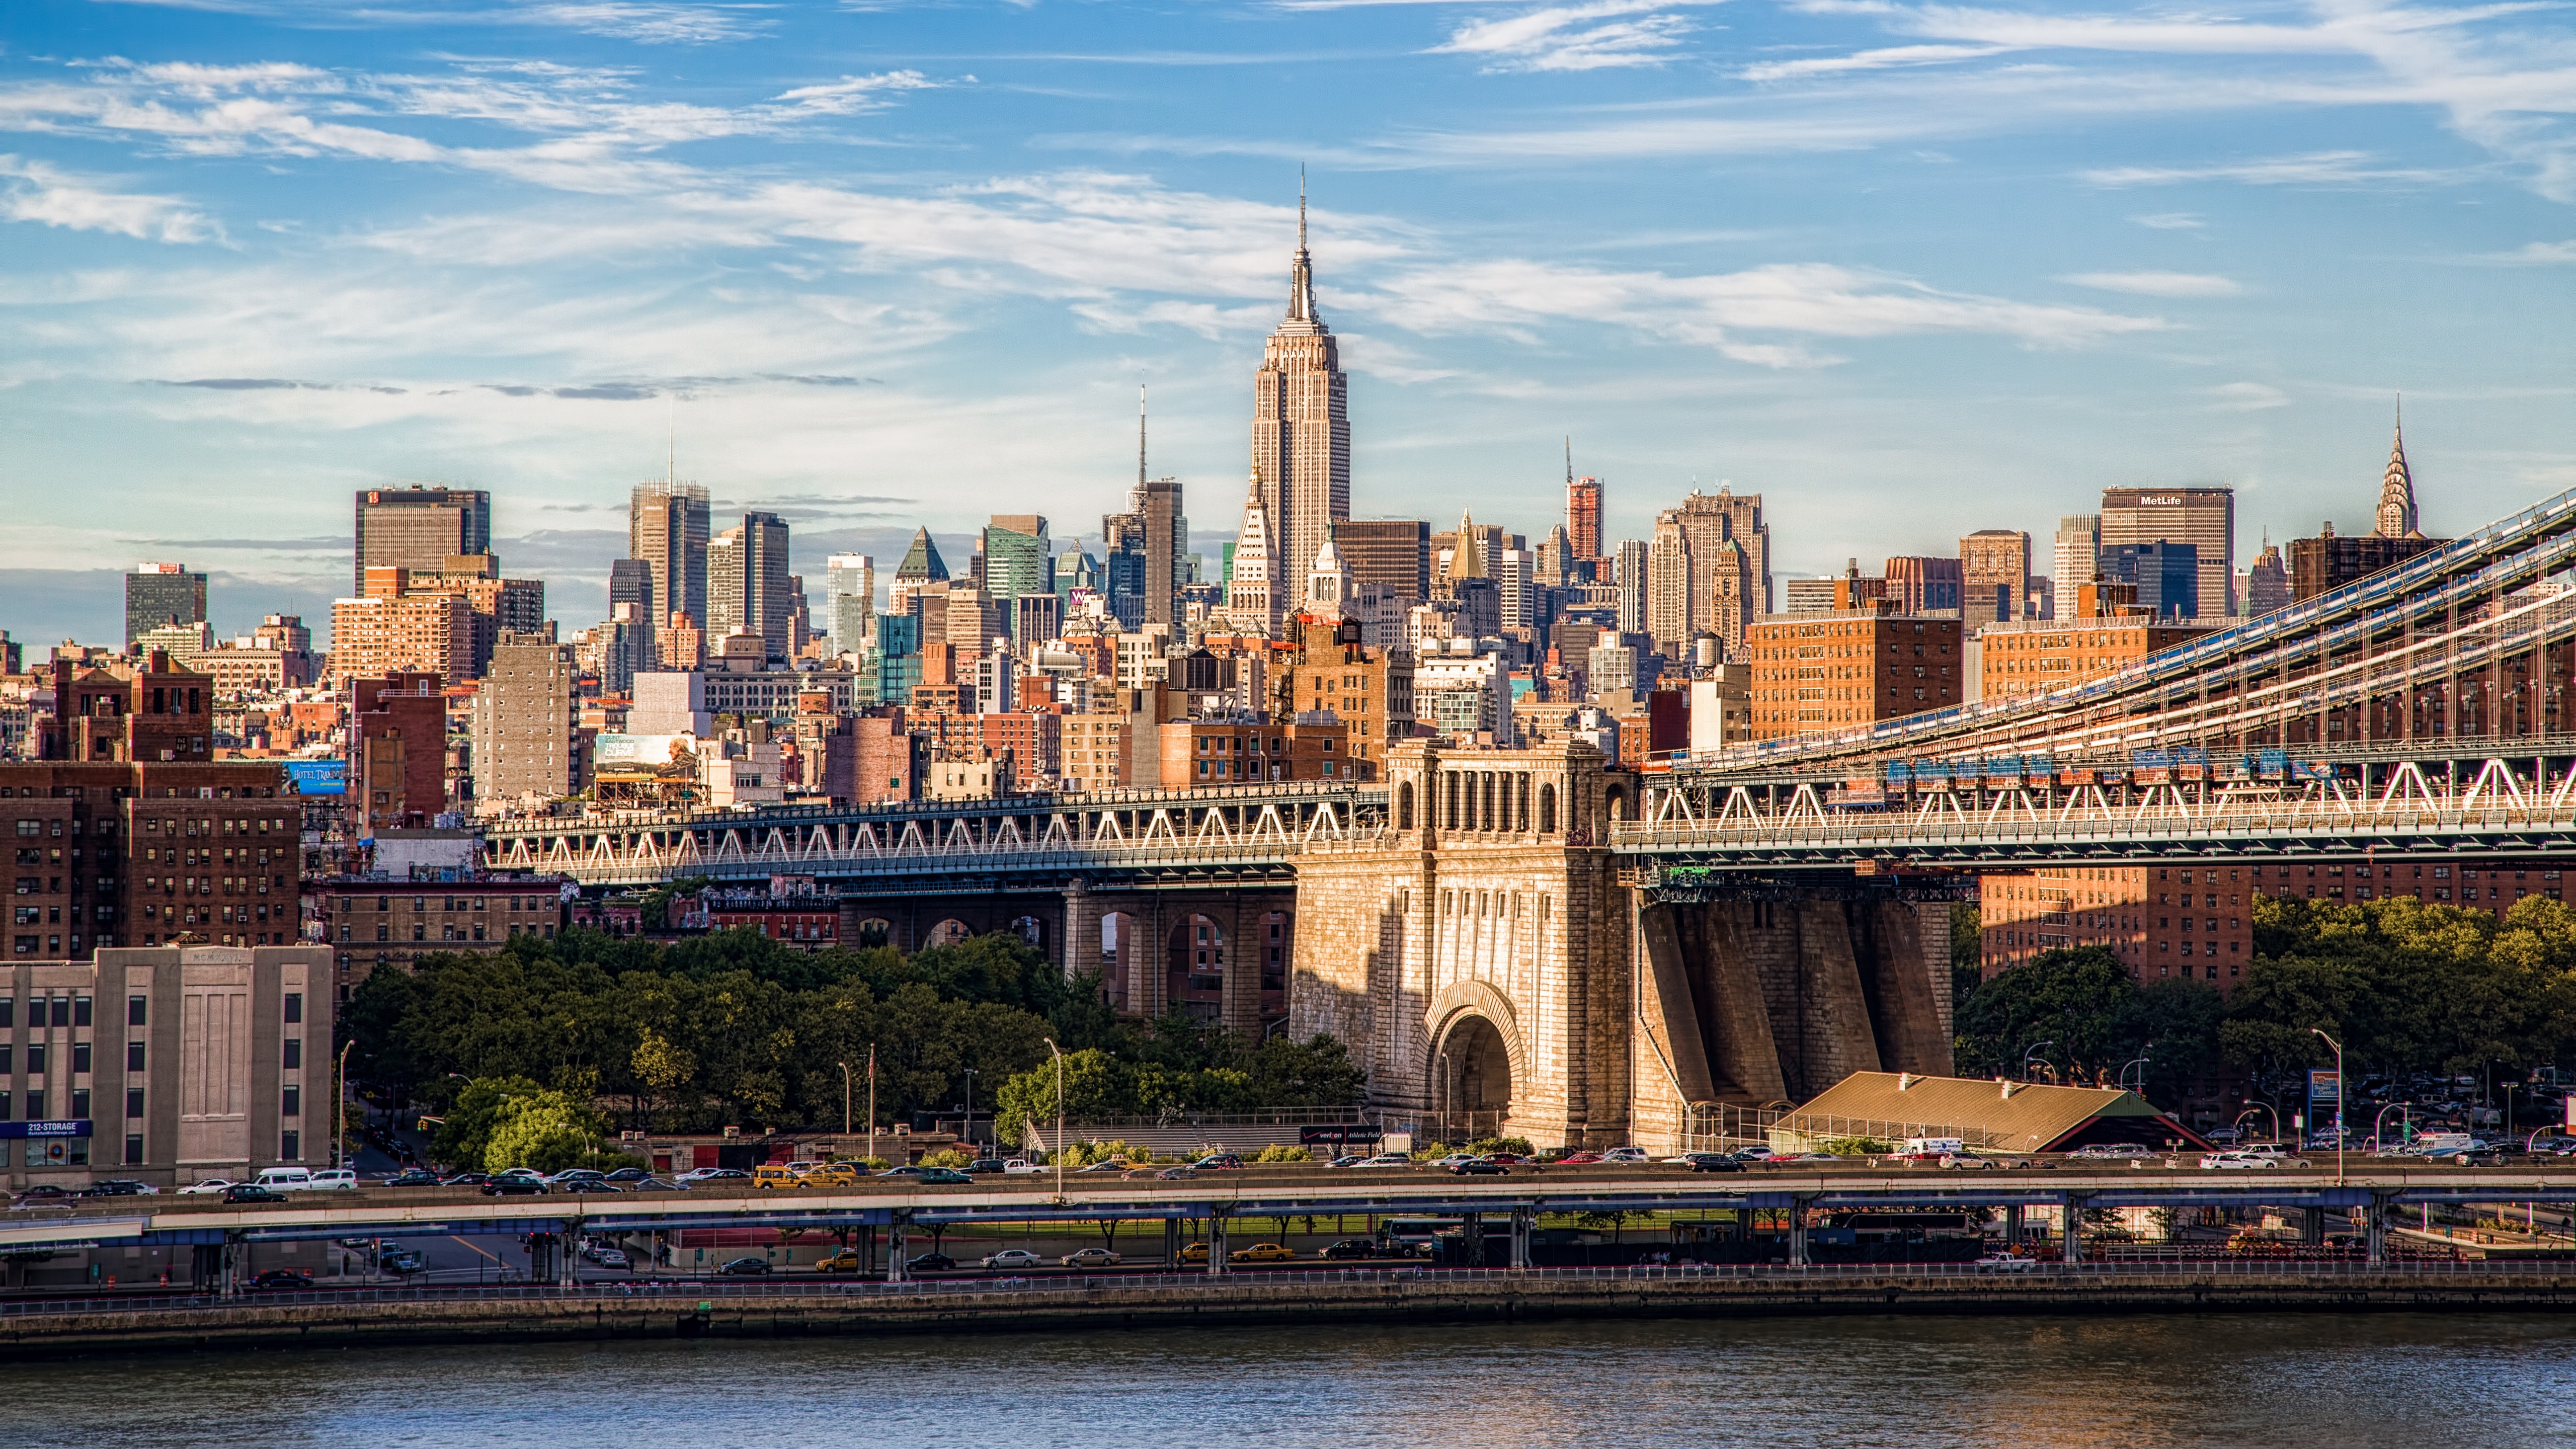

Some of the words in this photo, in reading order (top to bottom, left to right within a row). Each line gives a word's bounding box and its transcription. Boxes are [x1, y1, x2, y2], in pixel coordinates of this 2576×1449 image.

[1701, 501, 1718, 512] GE
[1072, 591, 1085, 602] W
[294, 769, 315, 779] HOTEL
[2314, 1077, 2337, 1085] Pathmark
[28, 1122, 76, 1131] 212-STORAGE
